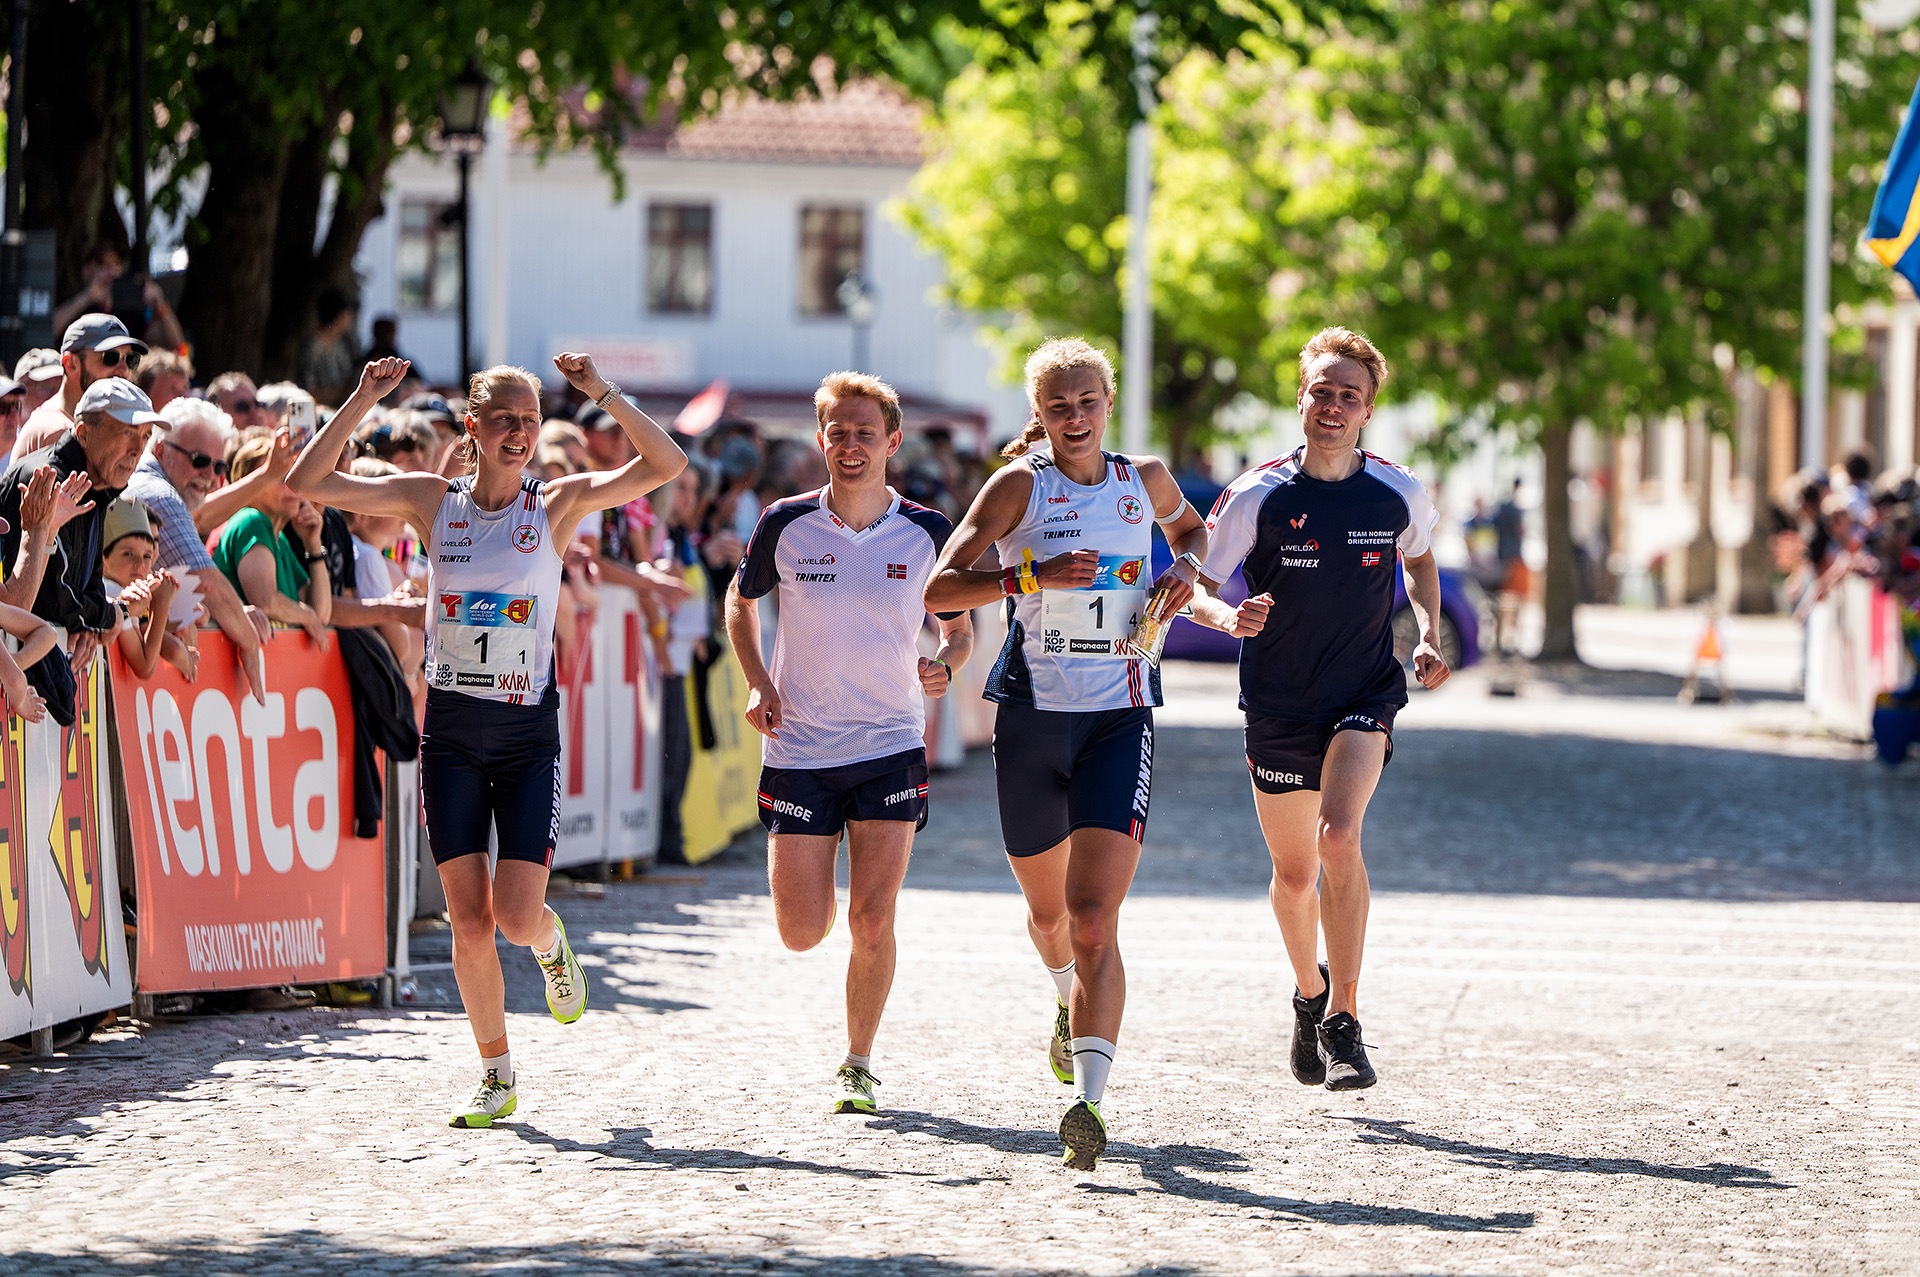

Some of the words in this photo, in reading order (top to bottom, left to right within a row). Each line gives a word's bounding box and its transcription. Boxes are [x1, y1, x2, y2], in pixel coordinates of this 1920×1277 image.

[1043, 515, 1075, 523] LIVELOX
[1043, 529, 1081, 540] TRIMTEX
[438, 554, 472, 563] TRIMTEX
[798, 557, 831, 565] LIVELOX
[1280, 556, 1320, 568] TRIMTEX
[795, 572, 837, 583] TRIMTEX
[1088, 595, 1104, 629] 1
[1129, 612, 1138, 627] 4
[1045, 629, 1060, 637] LID
[474, 632, 489, 664] 1
[1071, 641, 1109, 650] bagheera
[518, 649, 526, 664] 1
[458, 675, 492, 684] bagheera
[497, 669, 531, 691] SKARA
[136, 648, 340, 877] renta
[1132, 723, 1152, 818] TRIMTEX
[1256, 765, 1304, 786] NORGE
[883, 787, 918, 806] TRIMTEX
[772, 799, 813, 823] NORGE
[184, 916, 327, 974] MASKINUTHYRNING
